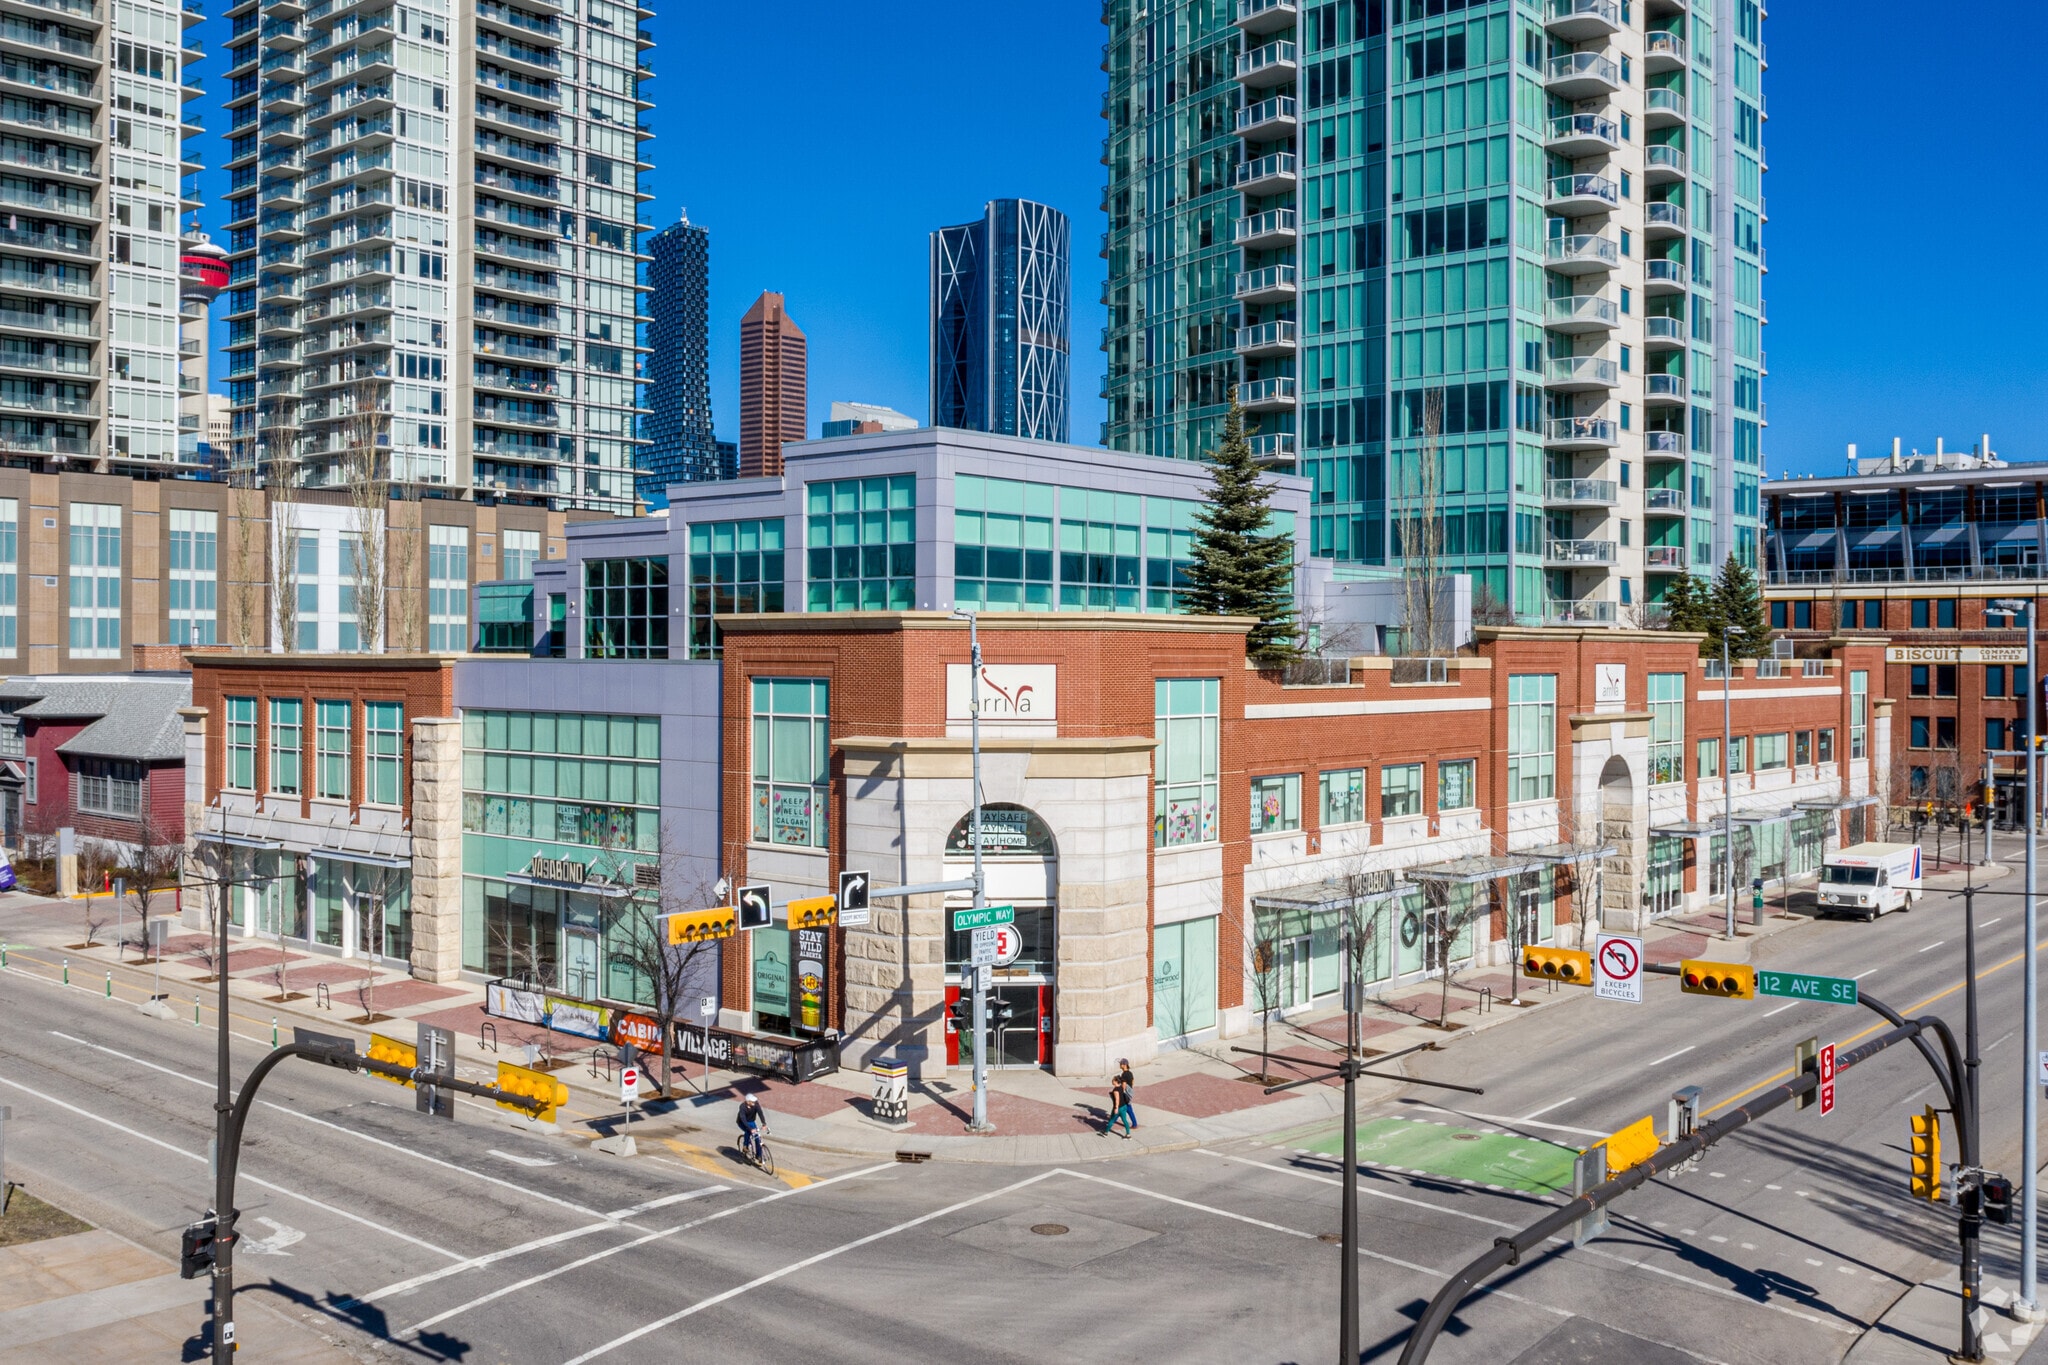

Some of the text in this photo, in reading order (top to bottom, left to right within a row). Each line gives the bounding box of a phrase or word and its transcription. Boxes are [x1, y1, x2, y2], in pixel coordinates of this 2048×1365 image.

[1894, 649, 1963, 660] BISCUIT
[558, 805, 581, 815] FLATTEN
[564, 815, 575, 823] THE
[776, 817, 808, 826] CALGARY
[1000, 813, 1027, 821] SAFE
[560, 824, 577, 833] CURVE
[970, 824, 997, 832] SAY
[969, 836, 996, 844] SAY
[532, 858, 584, 883] VAGABOND
[957, 909, 1012, 927] OLYMPIC WAY
[799, 930, 823, 943] STAY
[975, 930, 995, 940] YIELD
[799, 941, 822, 953] WILD
[799, 951, 822, 959] ALBERTA
[757, 971, 786, 982] ORIGINAL
[1604, 980, 1631, 989] EXCEPT
[1763, 976, 1852, 1000] 12 AVE SE
[1600, 988, 1635, 998] BICYCLES
[570, 1012, 595, 1024] ANNEX
[617, 1019, 662, 1042] CABIN
